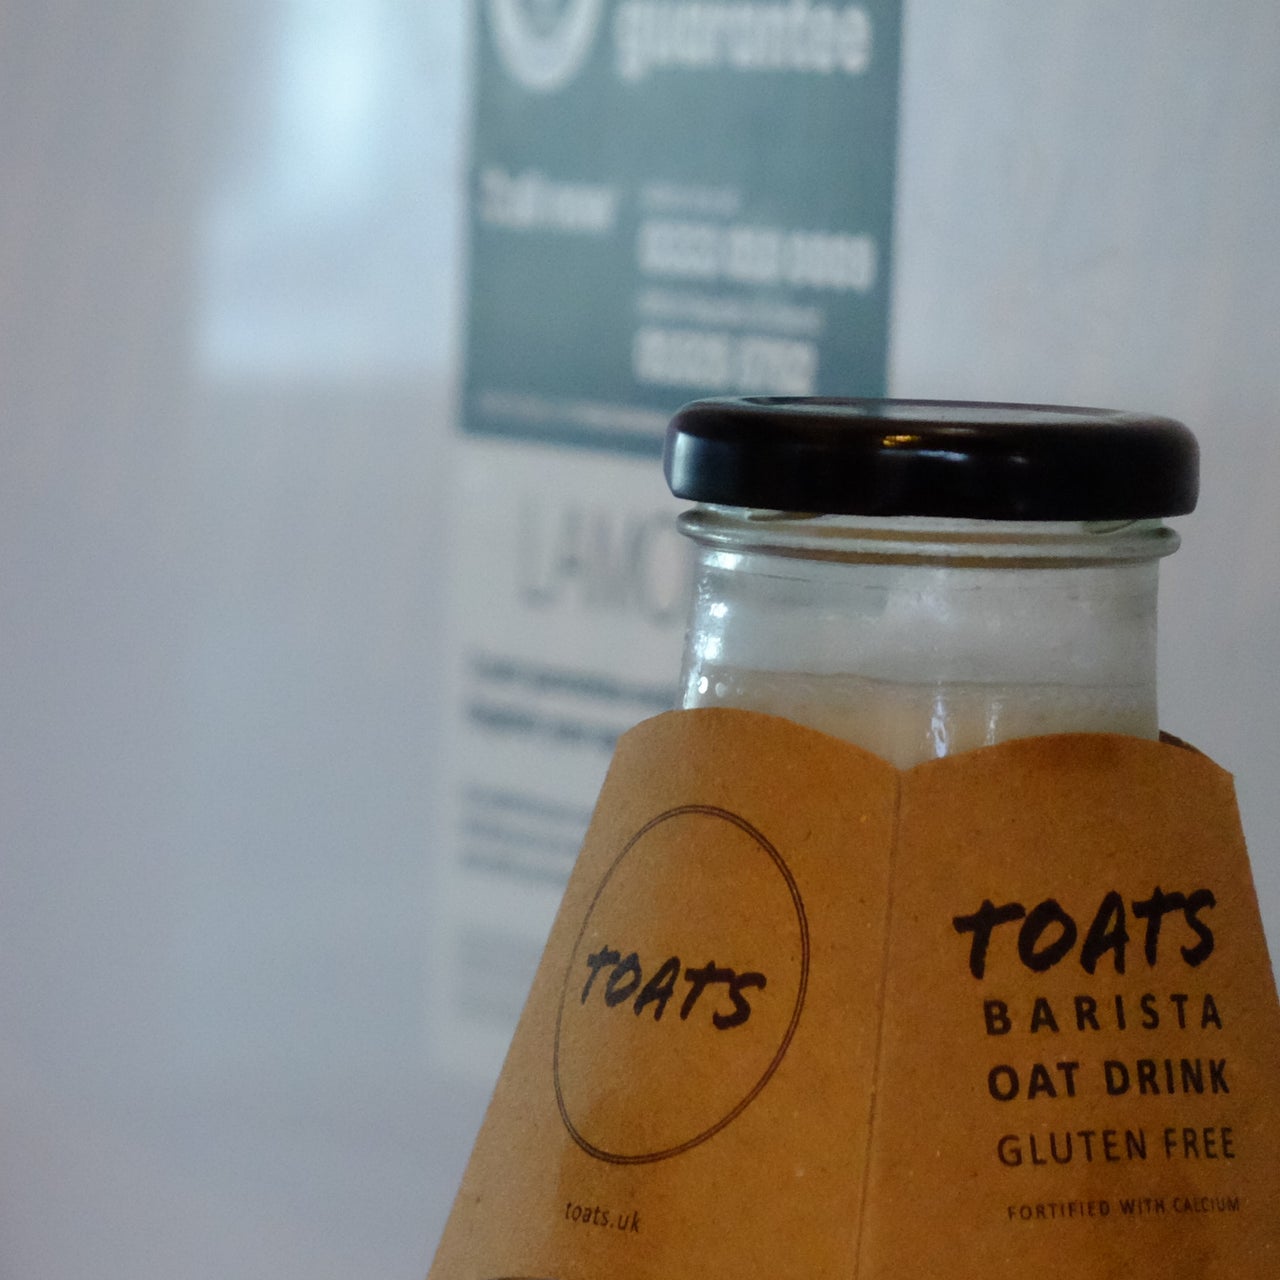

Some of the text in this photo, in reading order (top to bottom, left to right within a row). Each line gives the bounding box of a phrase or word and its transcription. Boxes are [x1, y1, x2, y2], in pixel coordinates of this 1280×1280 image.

[614, 1, 870, 80] guarantee
[952, 886, 1217, 980] TOATS
[581, 945, 767, 1030] TOATS
[983, 993, 1223, 1036] BARISTA
[988, 1058, 1230, 1102] OAT DRINK
[997, 1126, 1236, 1167] GLUTEN FREE
[565, 1202, 641, 1233] toats.uk
[1007, 1196, 1241, 1222] FORTIFIED WITH CALCIUM
